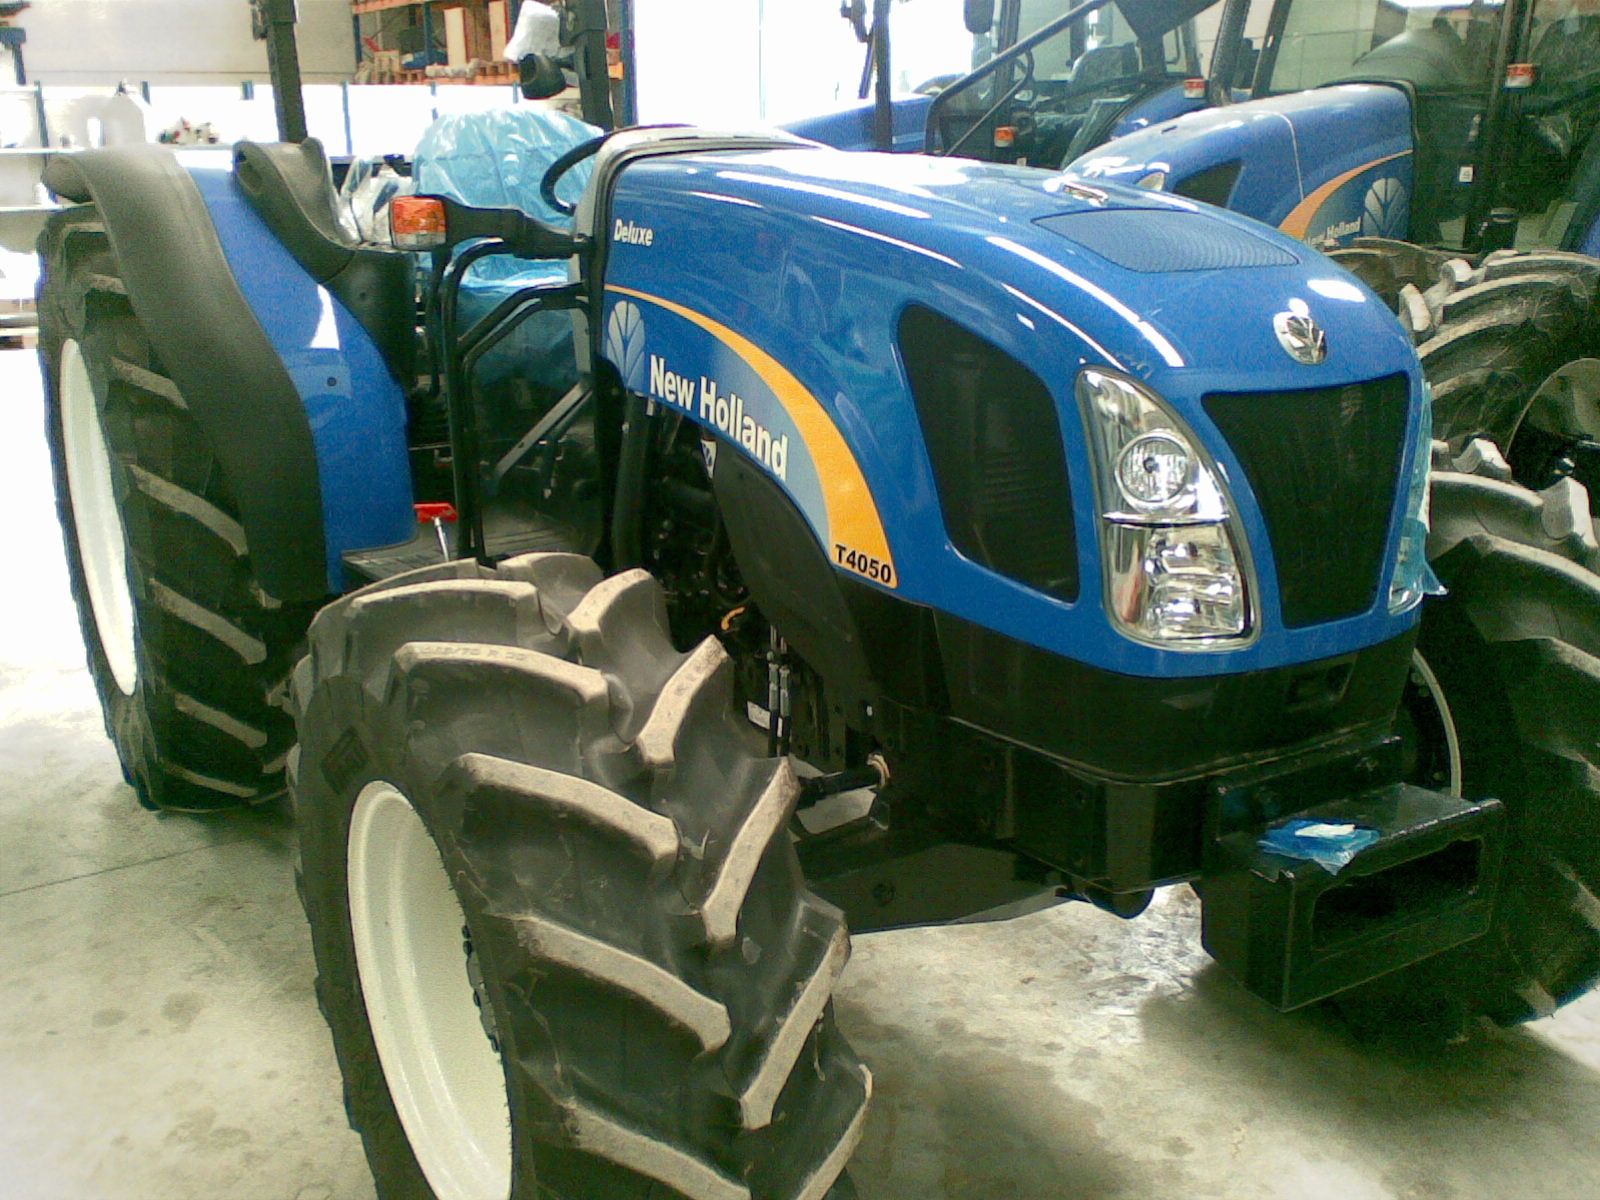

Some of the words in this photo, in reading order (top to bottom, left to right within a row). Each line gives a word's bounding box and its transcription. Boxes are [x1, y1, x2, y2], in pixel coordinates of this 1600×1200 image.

[613, 218, 654, 247] Deluxe
[650, 354, 696, 411] New
[700, 375, 788, 481] Holland
[835, 544, 891, 583] T4050
